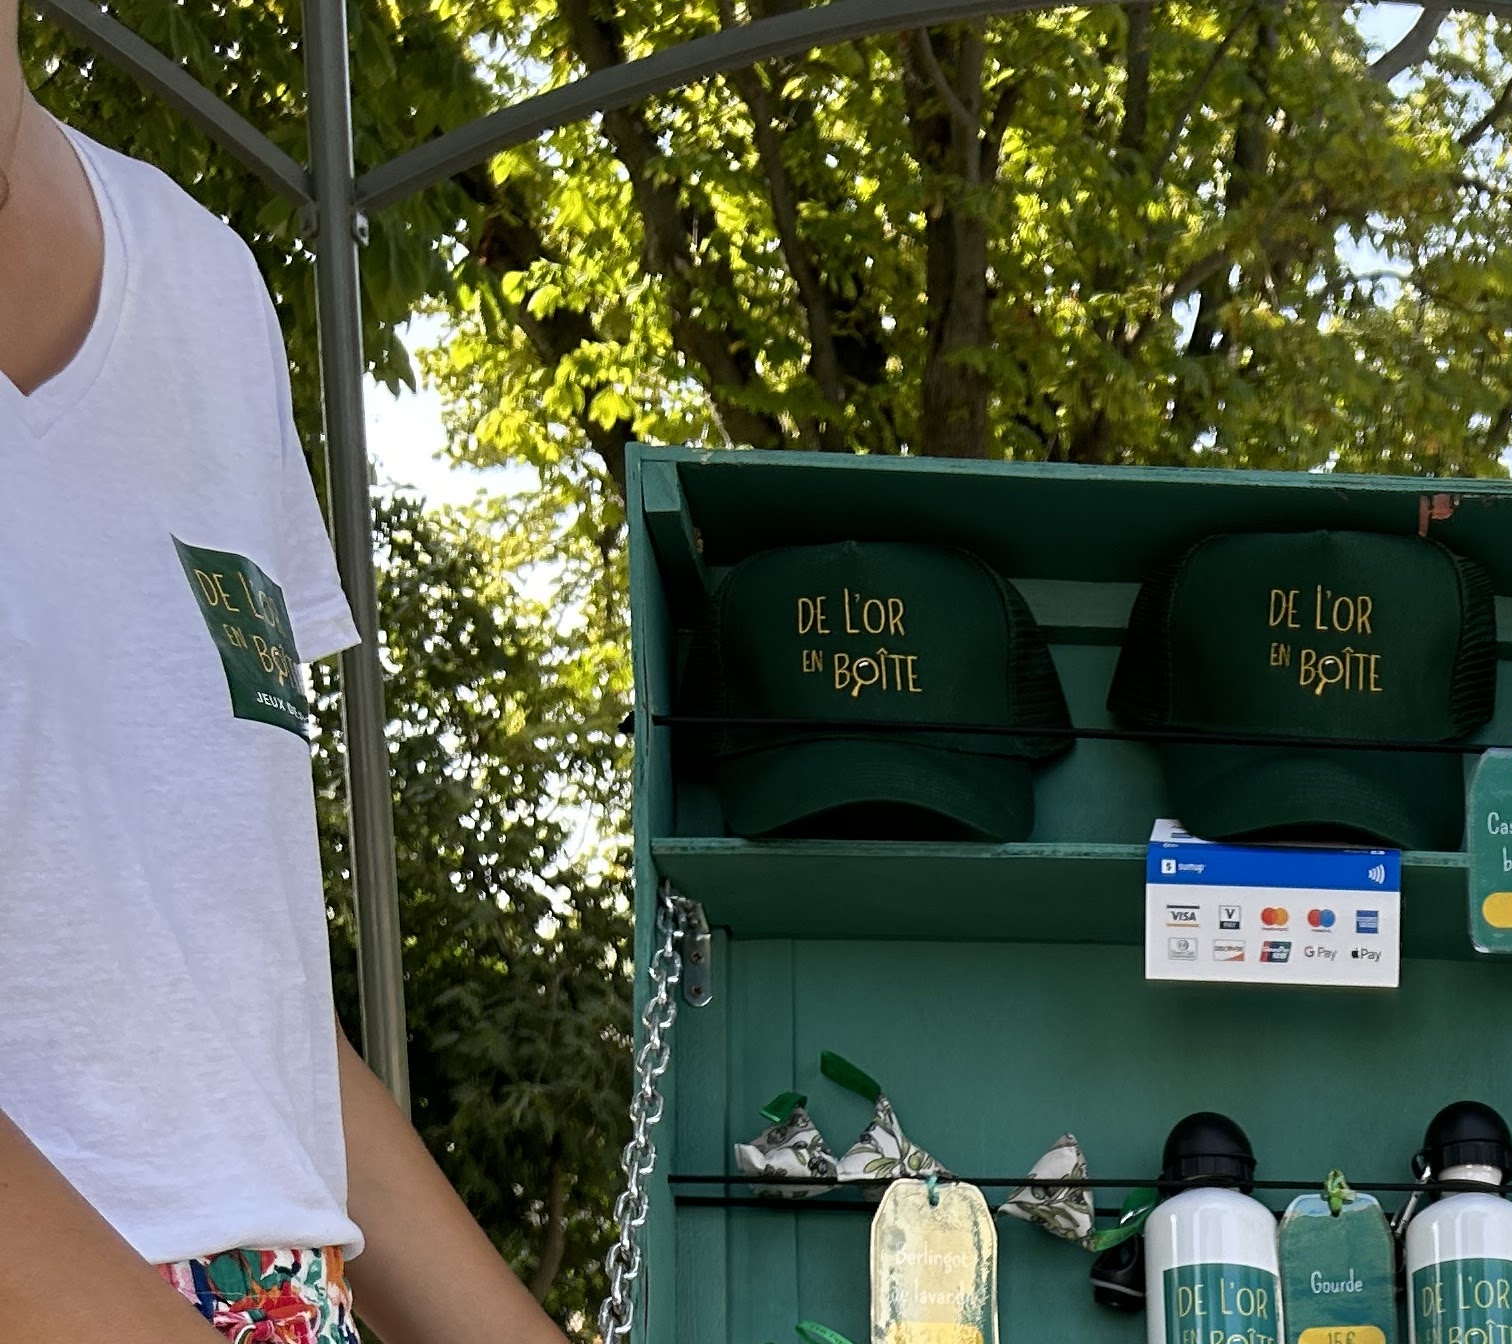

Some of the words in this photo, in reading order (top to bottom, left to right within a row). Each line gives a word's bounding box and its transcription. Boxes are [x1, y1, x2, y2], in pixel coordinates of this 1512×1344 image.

[194, 569, 240, 612] DE
[1269, 589, 1300, 628] DE
[1316, 585, 1372, 634] L'OR
[798, 596, 831, 634] DE
[844, 588, 905, 636] L'OR
[223, 624, 248, 649] EN
[803, 650, 823, 672] EN
[834, 647, 923, 697] BOÎTE
[1270, 643, 1291, 666] EN
[1300, 647, 1384, 696] BOÎTE
[257, 692, 286, 711] JEUX
[1171, 911, 1196, 921] VISA
[1361, 948, 1381, 962] Pay
[1178, 1284, 1207, 1318] DE
[1219, 1278, 1269, 1319] L'OR
[1310, 1269, 1362, 1295] Gourde
[1422, 1281, 1444, 1317] DE
[1458, 1275, 1511, 1309] L'OR
